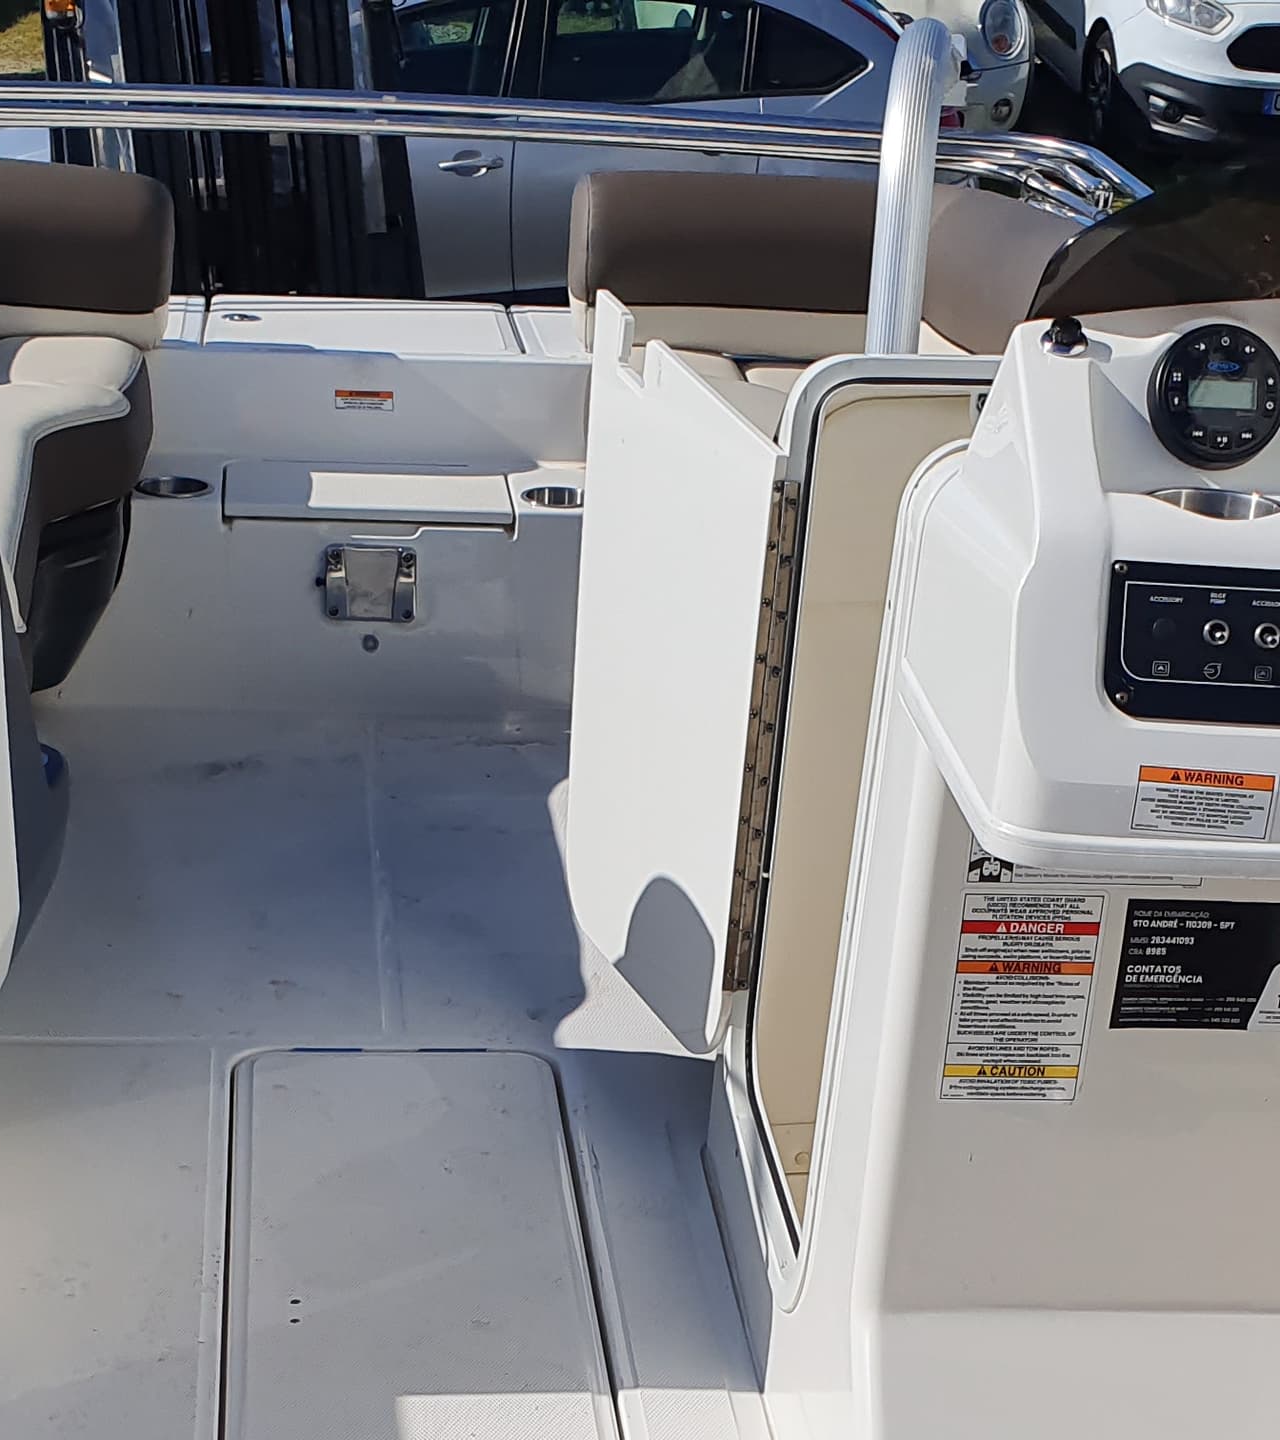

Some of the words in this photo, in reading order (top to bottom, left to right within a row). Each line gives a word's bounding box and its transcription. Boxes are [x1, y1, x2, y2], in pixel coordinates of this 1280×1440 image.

[1184, 771, 1244, 786] WARNING
[1010, 923, 1065, 934] DANGER
[1002, 962, 1061, 973] WARNING
[1126, 964, 1182, 974] CONTATOS
[1125, 974, 1139, 983] DE
[1139, 973, 1203, 983] EMERGÊNCIA
[990, 1066, 1045, 1076] CAUTION
